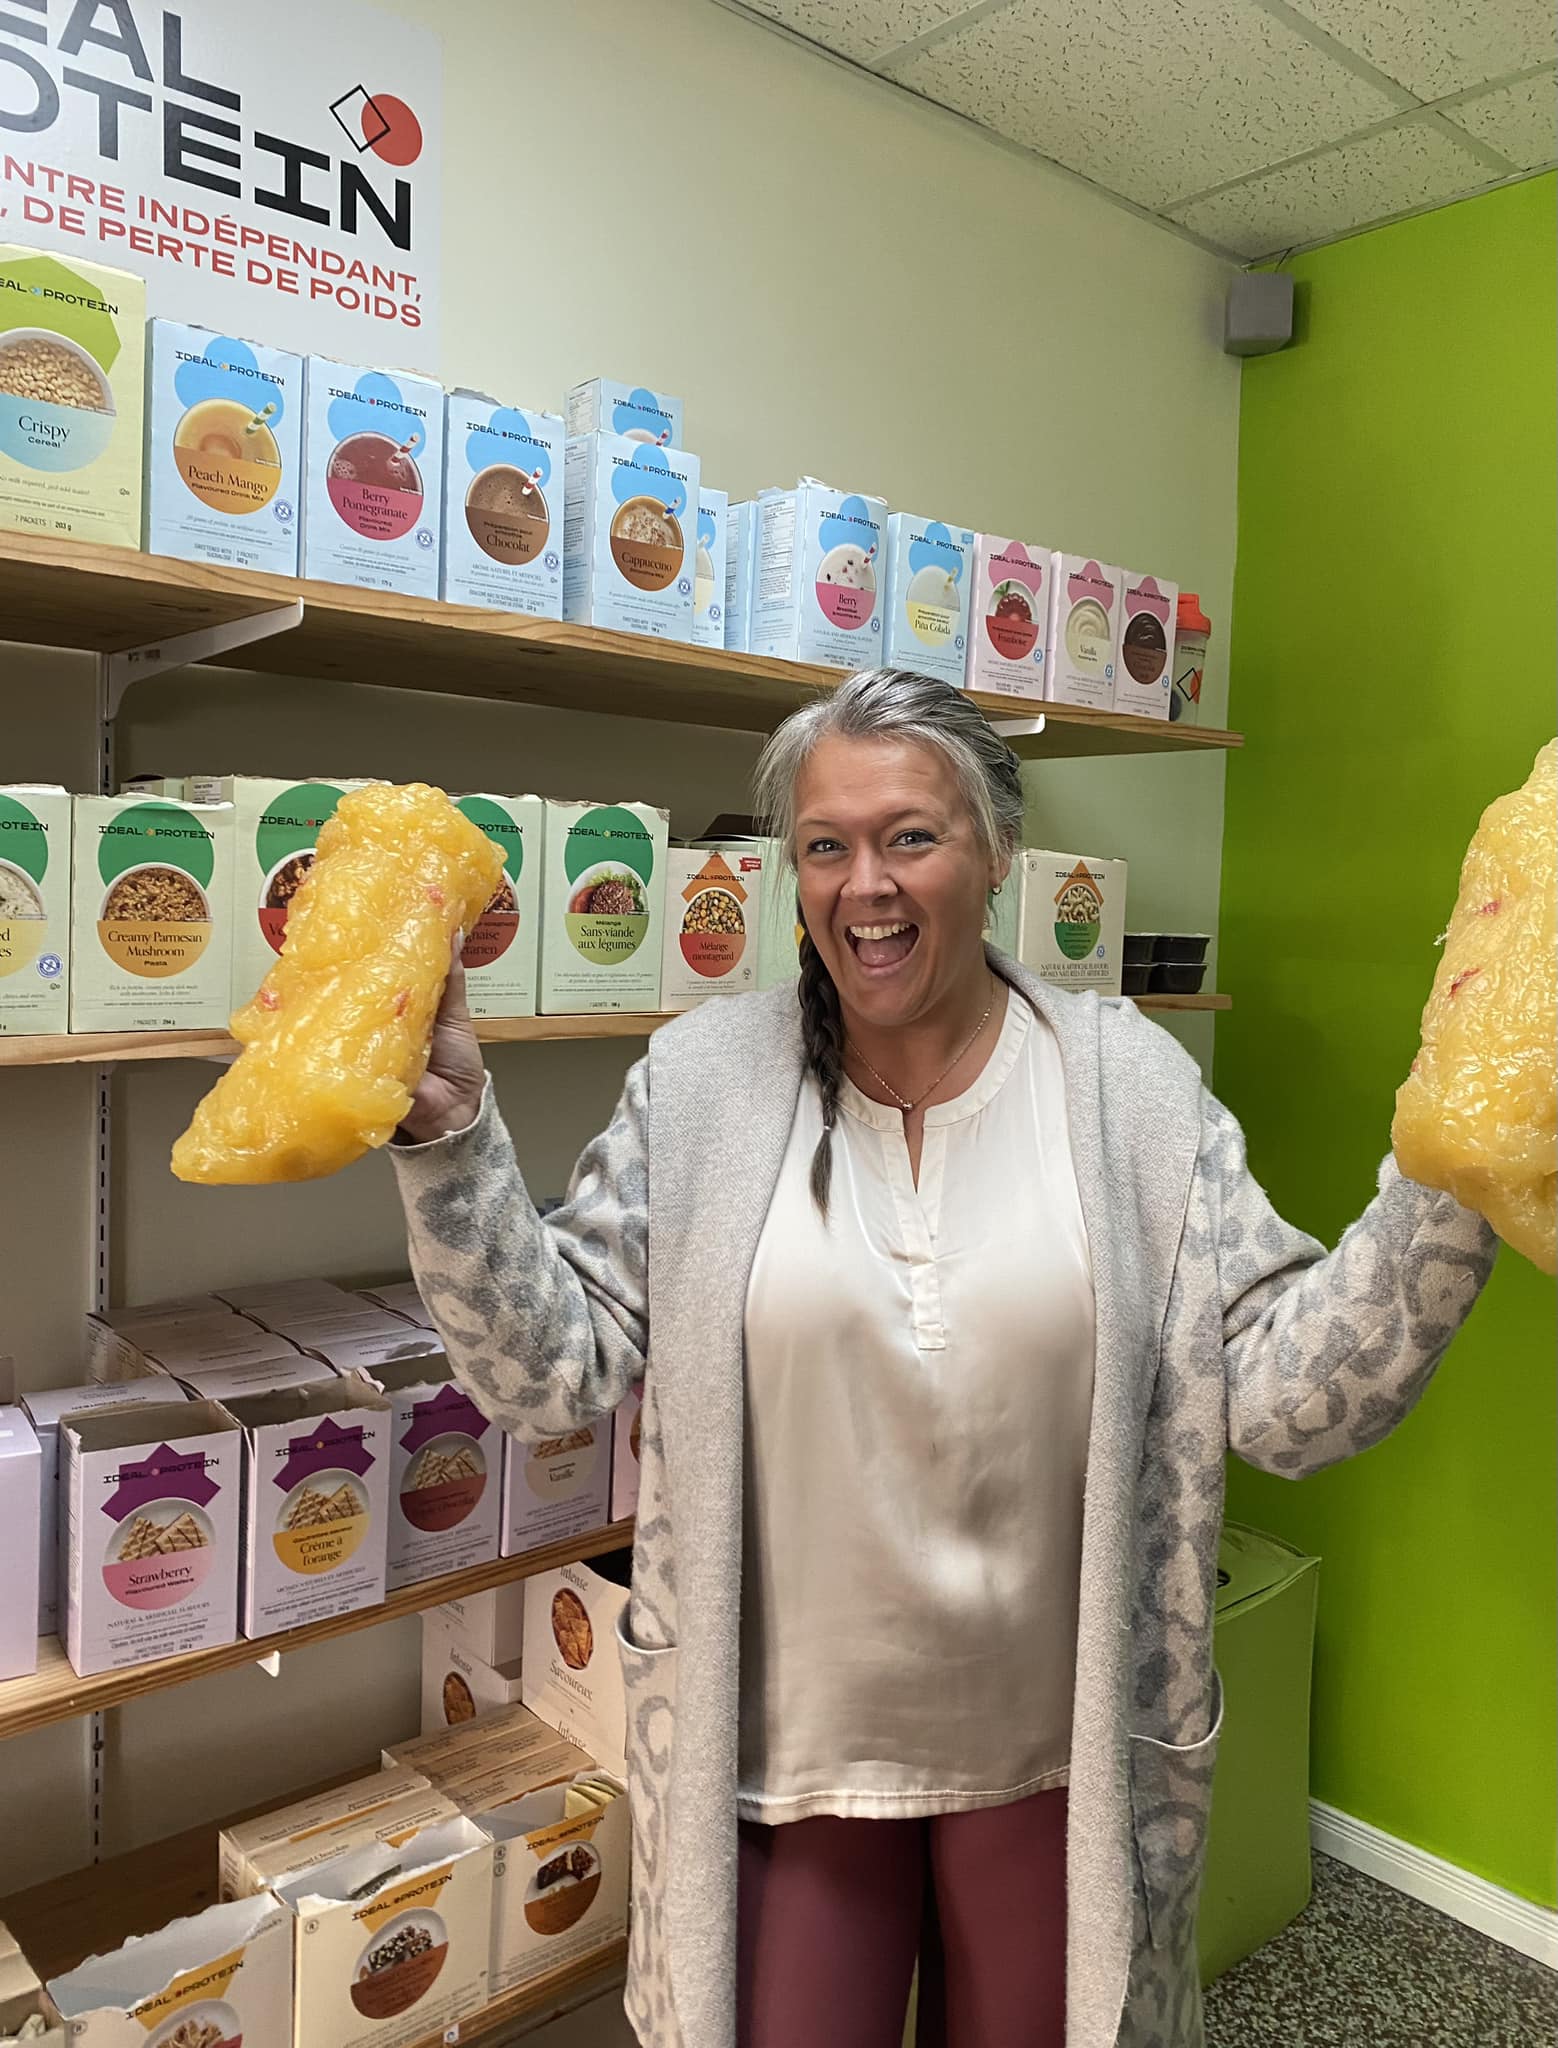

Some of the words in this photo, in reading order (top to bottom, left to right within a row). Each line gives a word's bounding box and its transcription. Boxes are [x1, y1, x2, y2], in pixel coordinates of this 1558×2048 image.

[0, 45, 411, 251] OTEIN
[138, 195, 421, 303] INDÉPENDANT,
[24, 195, 85, 235] DE
[99, 217, 235, 277] PERTE
[246, 259, 299, 295] DE
[310, 276, 421, 328] POIDS
[43, 288, 119, 315] PROTEIN
[175, 350, 218, 370] IDEAL
[229, 365, 285, 387] PROTEIN
[328, 387, 366, 403] IDEAL
[376, 399, 427, 418] PROTEIN
[613, 398, 636, 410] IDEAL
[641, 405, 673, 420] PROTEIN
[19, 415, 70, 442] Crispy
[466, 422, 499, 437] IDEAL
[508, 431, 552, 450] PROTEIN
[28, 436, 61, 448] Cereal
[612, 456, 641, 471] IDEAL
[648, 465, 688, 483] PROTEIN
[188, 465, 224, 484] Peach
[228, 474, 268, 494] Mango
[191, 482, 229, 495] Flavoured
[231, 490, 250, 500] Drink
[252, 494, 264, 502] Mix
[362, 488, 389, 504] Berry
[343, 496, 408, 520] Pomegranate
[820, 510, 846, 522] IDEAL
[853, 516, 881, 531] PROTEIN
[486, 534, 530, 553] Chocolat
[910, 534, 931, 545] IDEAL
[936, 540, 965, 553] PROTEIN
[621, 551, 672, 572] Cappuccino
[990, 553, 1010, 564] IDEAL
[1014, 559, 1042, 570] PROTEIN
[1069, 572, 1087, 582] IDEAL
[1091, 578, 1114, 589] PROTEIN
[839, 593, 857, 608] Berry
[929, 621, 951, 635] Colada
[259, 815, 303, 827] IDEAL
[99, 825, 143, 837] IDEAL
[155, 828, 215, 840] PROTEIN
[567, 827, 601, 838] IDEAL
[610, 830, 654, 841] PROTEIN
[1055, 871, 1074, 879] IDEAL
[108, 930, 151, 945] Creamy
[153, 931, 202, 943] Parmesan
[580, 925, 635, 938] Sans-viande
[126, 945, 185, 957] Mushroom
[578, 940, 597, 949] aux
[598, 937, 636, 952] légumes
[699, 941, 729, 951] Mélange
[692, 951, 734, 961] montagnard
[104, 1471, 147, 1484] IDEAL
[159, 1458, 219, 1475] PROTEIN
[300, 1539, 335, 1554] Crème
[336, 1536, 343, 1545] à
[303, 1550, 342, 1567] l'orange
[129, 1566, 192, 1585] Strawberry
[560, 1566, 589, 1591] Intense
[550, 1658, 593, 1701] Savoureux
[527, 1835, 556, 1851] IDEAL
[352, 1901, 391, 1922] IDEAL
[399, 1874, 453, 1901] PROTEIN
[125, 1995, 172, 2020] IDEAL
[182, 1960, 244, 1994] PROTEIN
